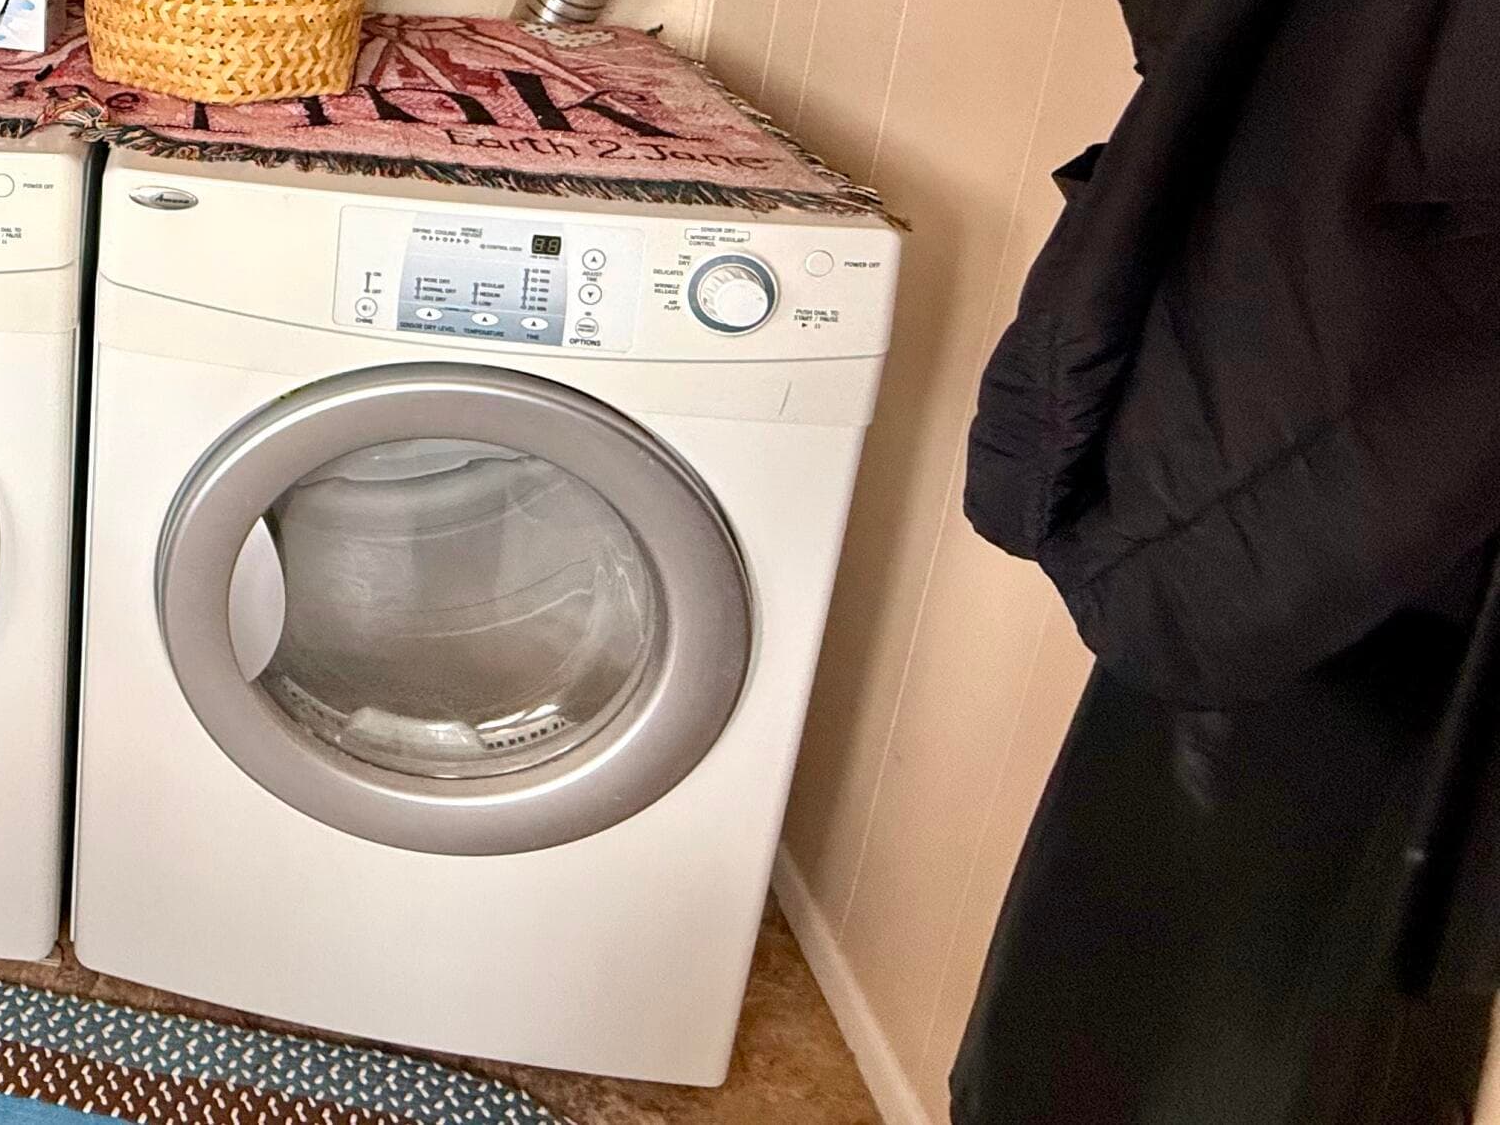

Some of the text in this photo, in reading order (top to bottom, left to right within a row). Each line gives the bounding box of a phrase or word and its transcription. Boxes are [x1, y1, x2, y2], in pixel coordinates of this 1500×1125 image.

[444, 128, 780, 171] Earth 2 Jane
[844, 260, 867, 268] POWER
[569, 337, 602, 347] OPTIONS
